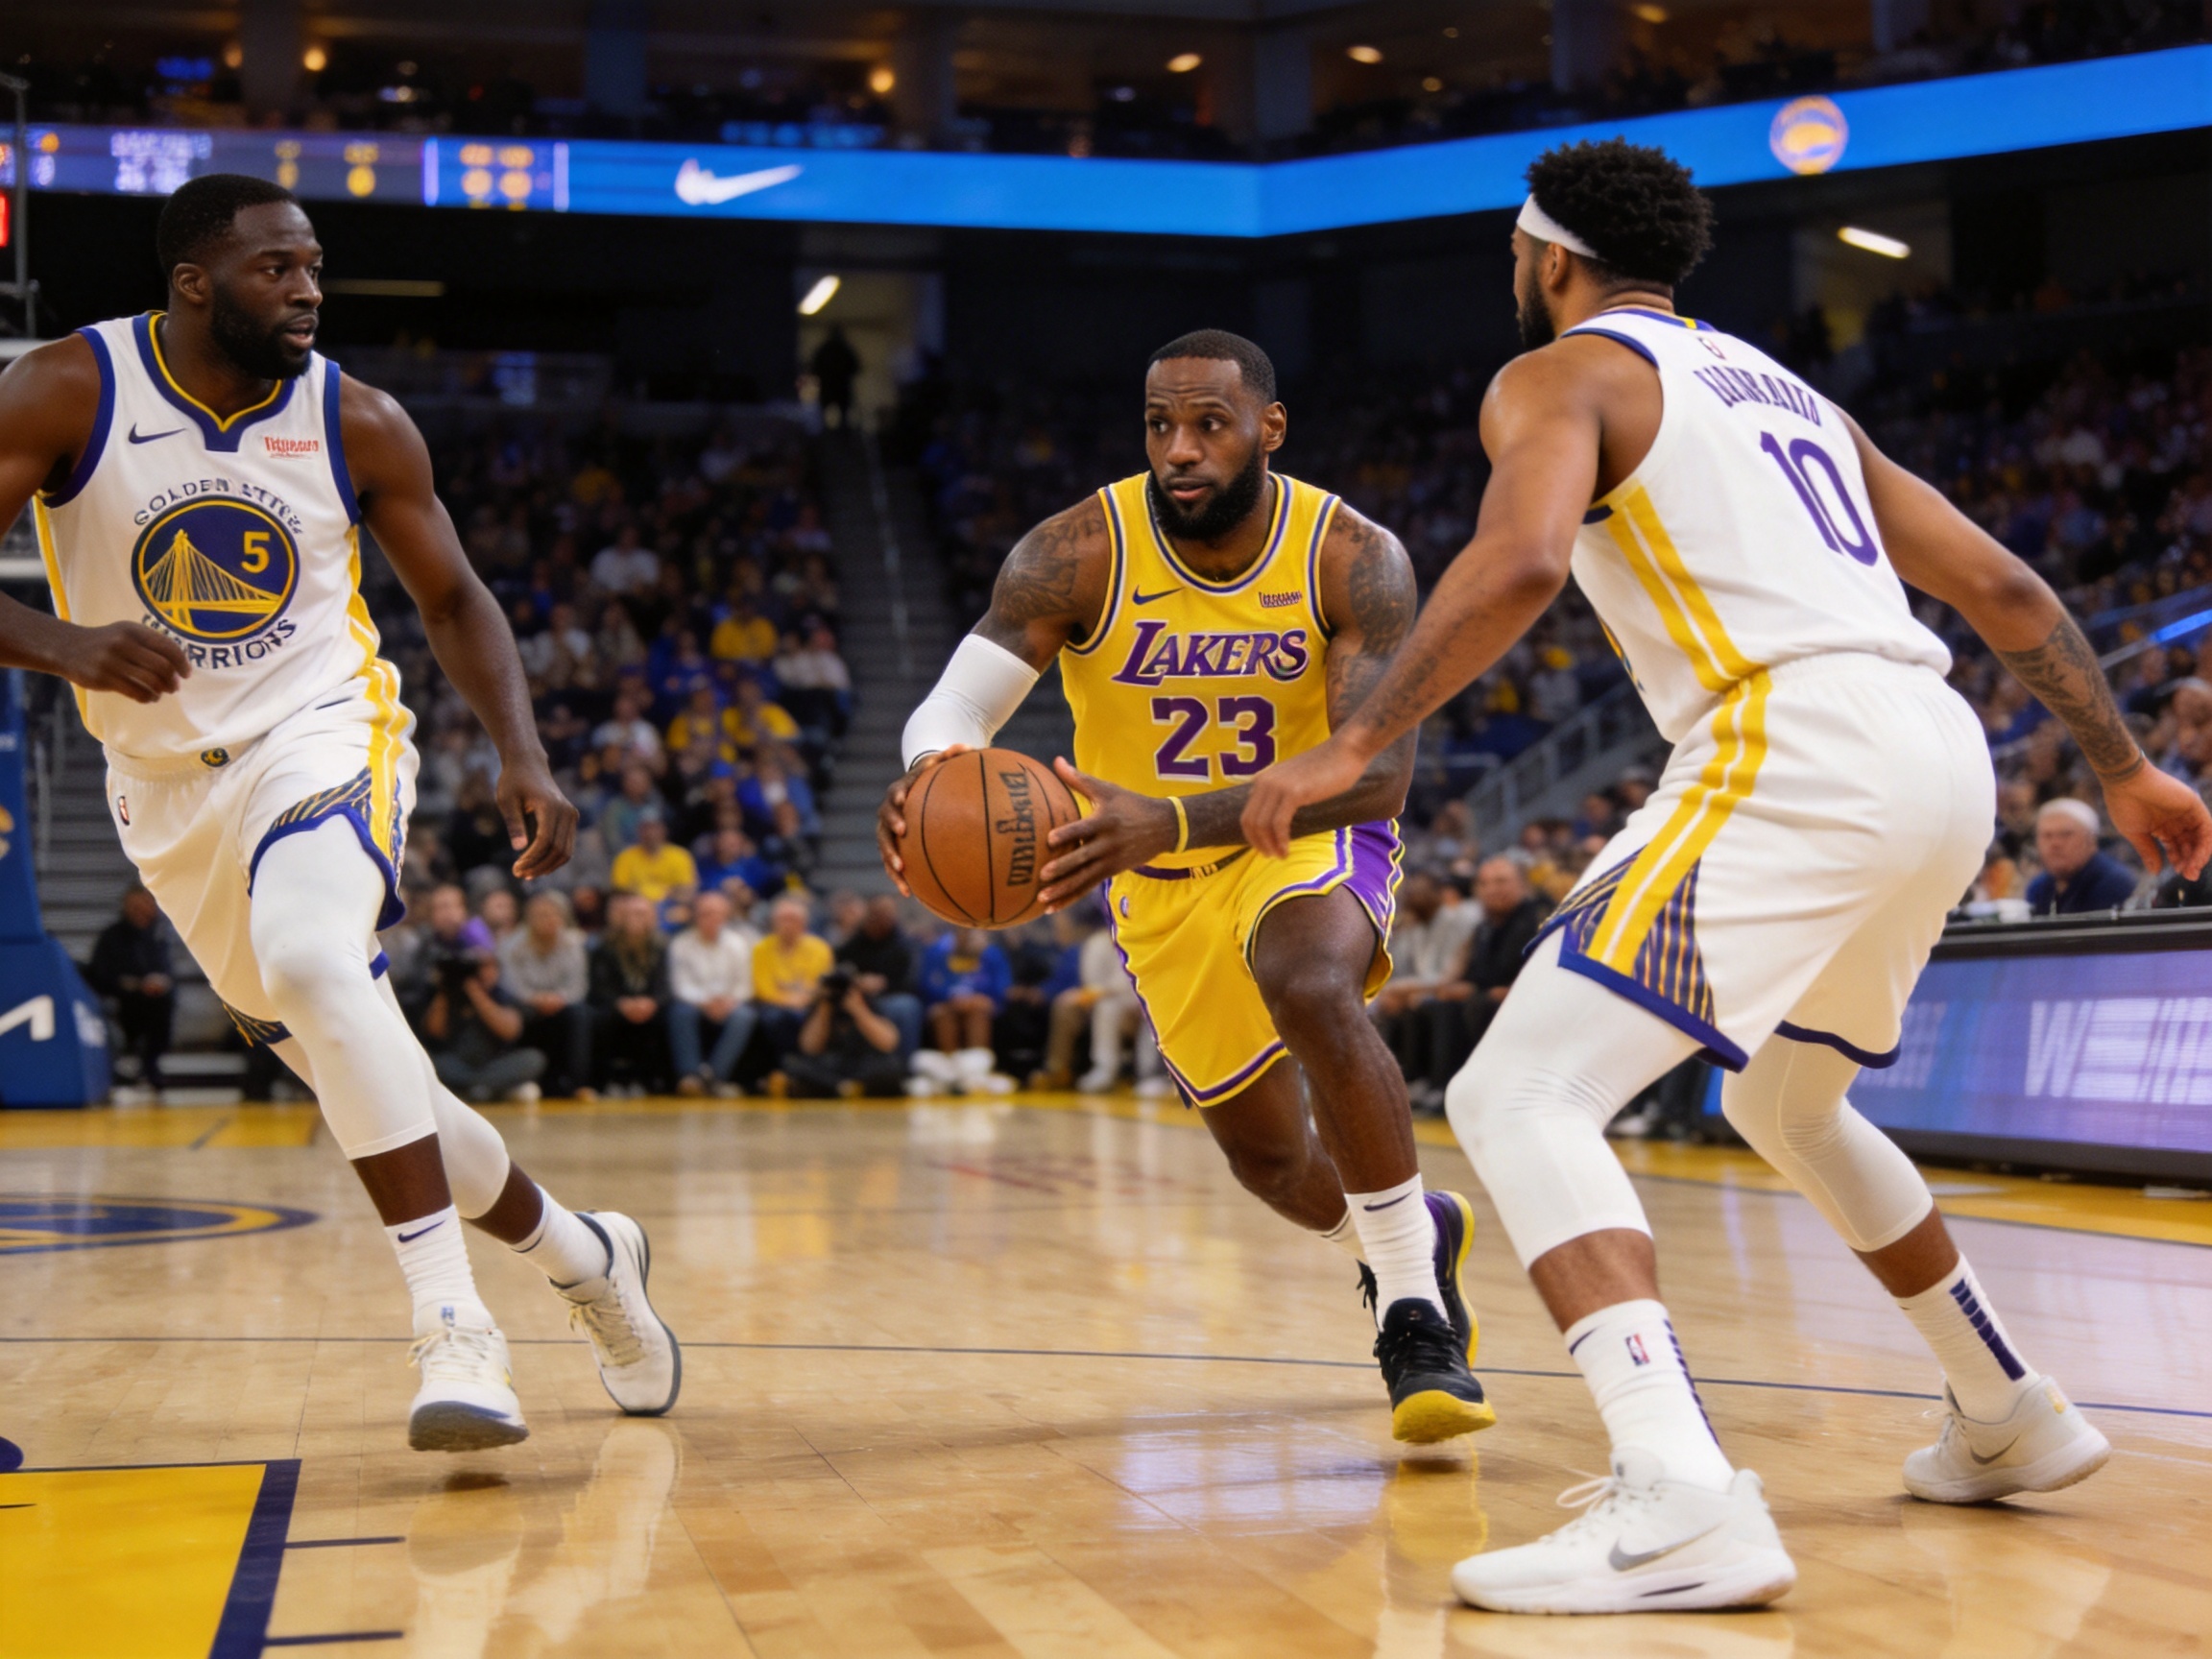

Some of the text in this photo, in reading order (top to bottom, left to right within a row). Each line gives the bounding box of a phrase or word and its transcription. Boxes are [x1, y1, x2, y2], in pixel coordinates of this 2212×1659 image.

[1759, 430, 1879, 567] 10
[241, 531, 272, 573] 5
[1111, 619, 1310, 687] LAKERS
[1150, 694, 1277, 783] 23
